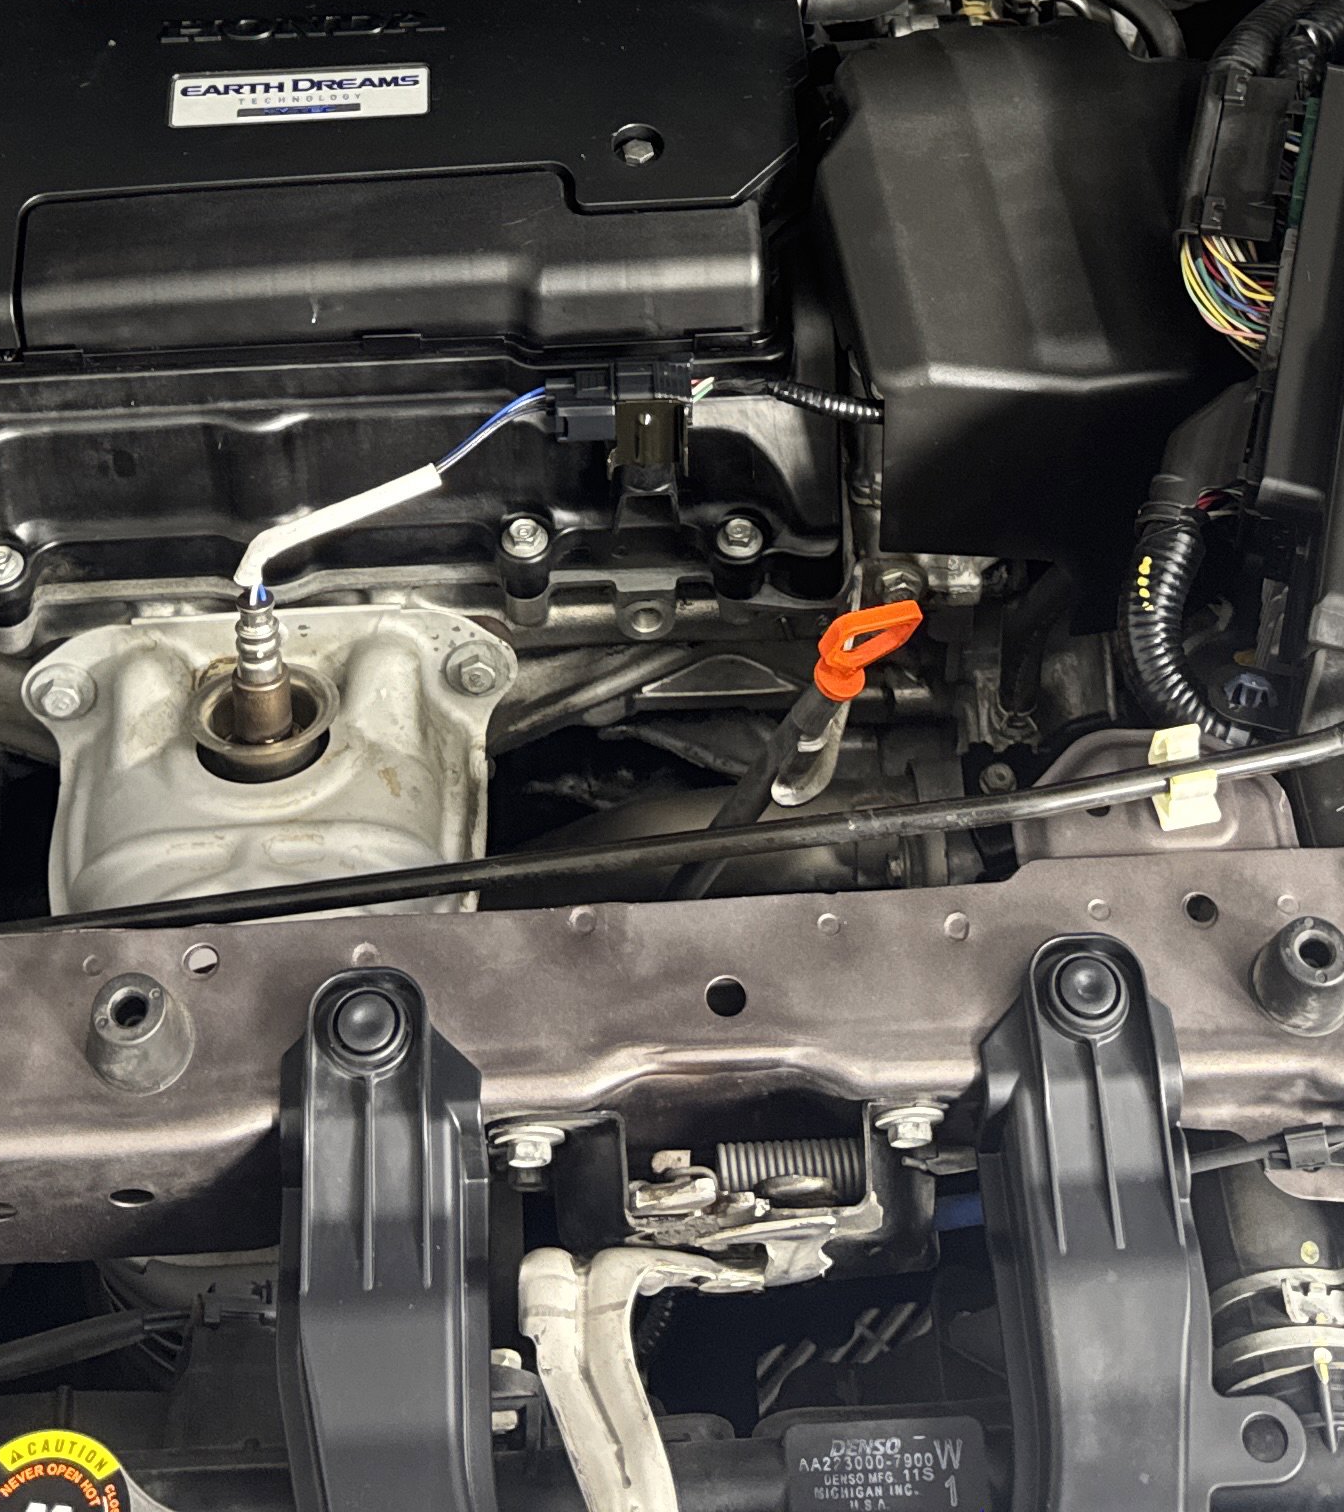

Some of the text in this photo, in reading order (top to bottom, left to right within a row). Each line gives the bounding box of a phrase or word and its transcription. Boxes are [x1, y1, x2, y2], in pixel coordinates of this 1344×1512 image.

[160, 14, 446, 44] HONDA
[180, 81, 285, 97] EARTH
[238, 93, 361, 105] TECHNOLOGY
[27, 1439, 109, 1472] CAUTION
[829, 1438, 963, 1470] DENSO W
[0, 1463, 101, 1507] NEVER OPEN HOT
[824, 1473, 865, 1486] DENSO
[814, 1484, 920, 1500] MICHIGAN INC.
